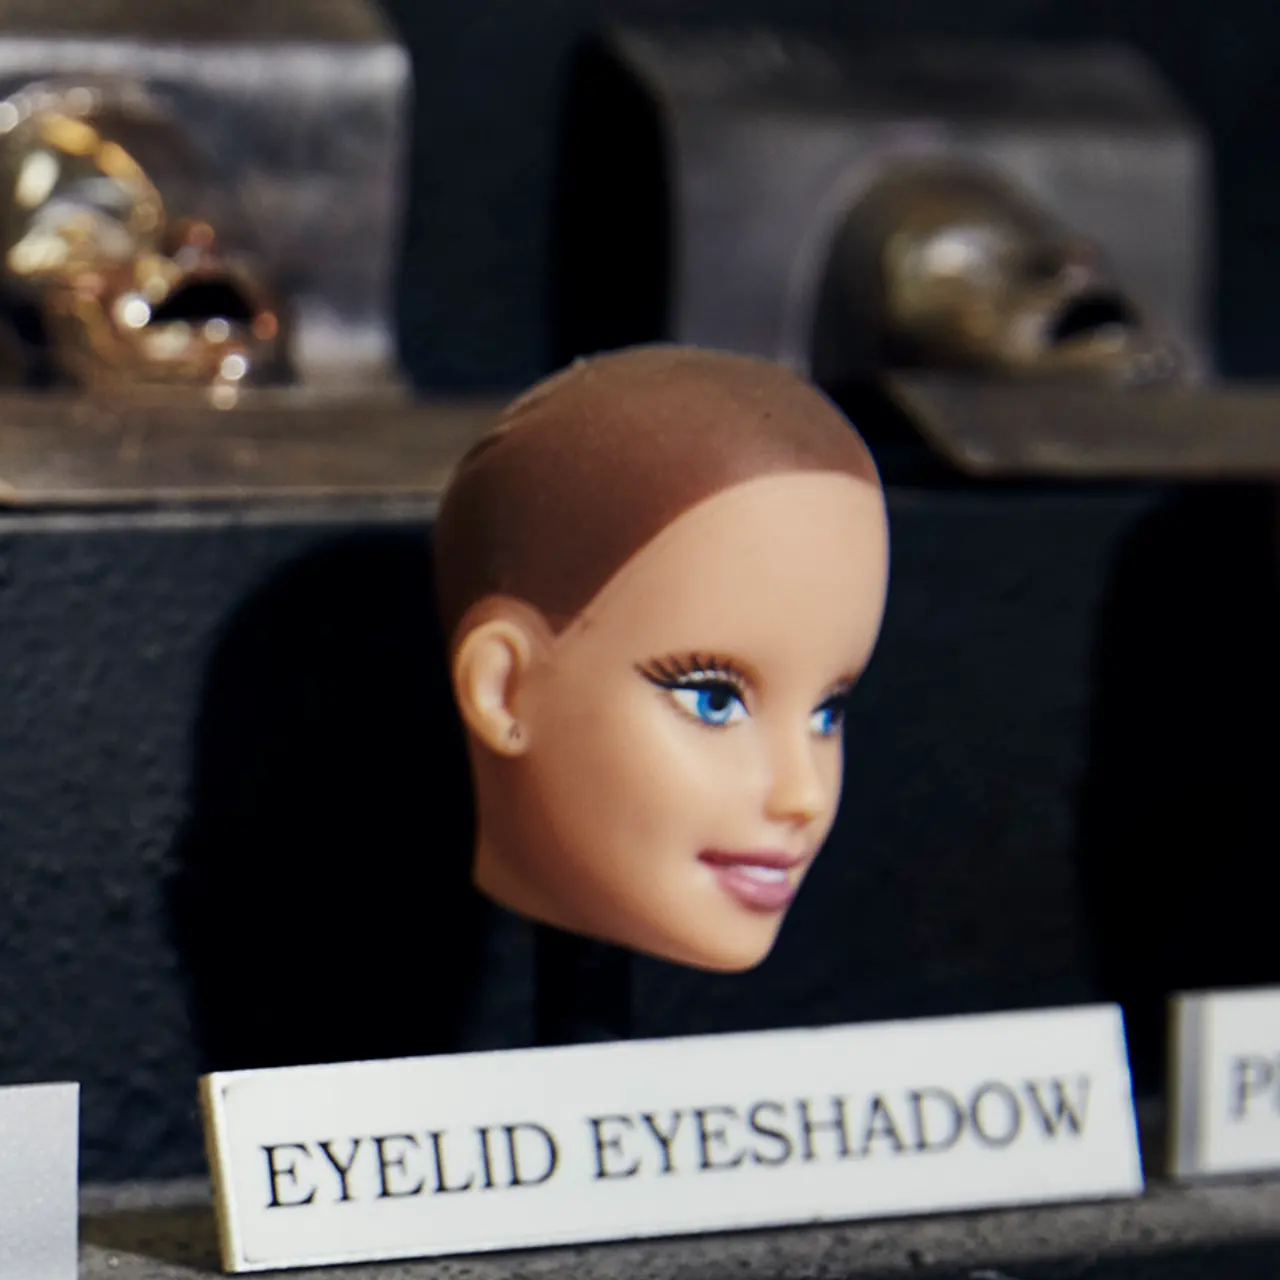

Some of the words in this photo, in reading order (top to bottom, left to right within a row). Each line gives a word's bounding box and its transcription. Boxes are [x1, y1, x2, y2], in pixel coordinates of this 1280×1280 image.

[1228, 1052, 1280, 1123] P
[261, 1122, 559, 1209] EYELID
[589, 1074, 1093, 1180] EYESHADOW
